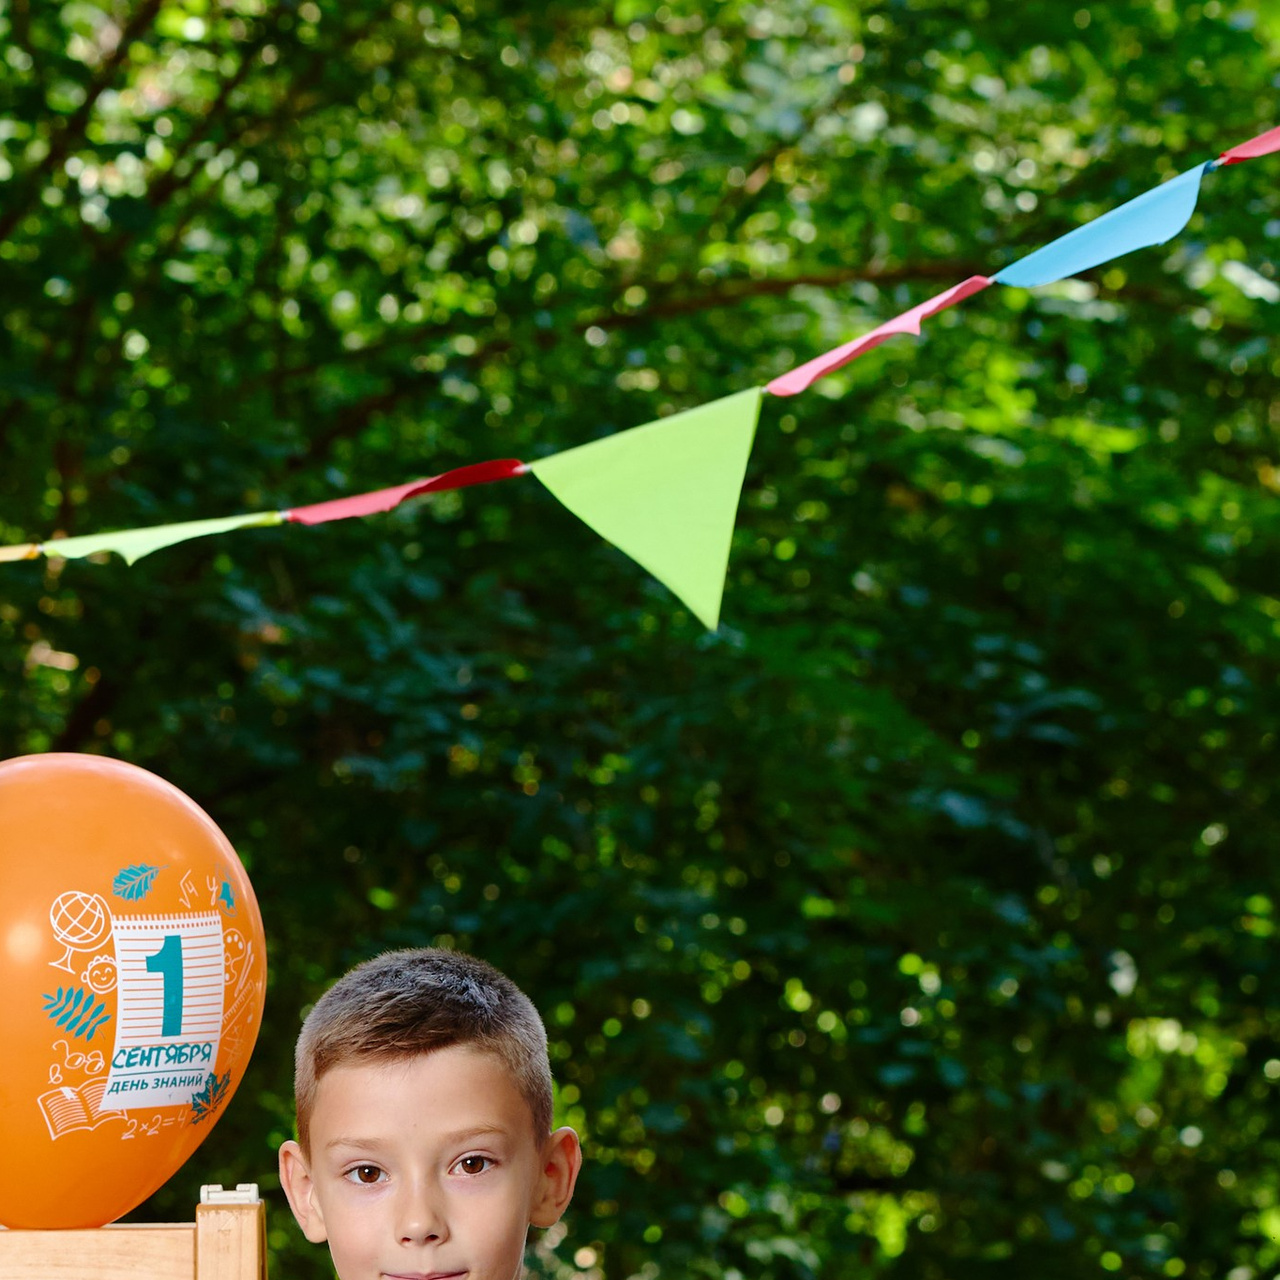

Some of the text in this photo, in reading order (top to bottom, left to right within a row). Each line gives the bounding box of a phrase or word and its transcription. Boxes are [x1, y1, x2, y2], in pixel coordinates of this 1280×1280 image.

[145, 934, 185, 1038] 1
[111, 1042, 213, 1069] СЕНТЯБРЯ
[107, 1072, 204, 1096] ДЕНЬ ЗНАНИЙ
